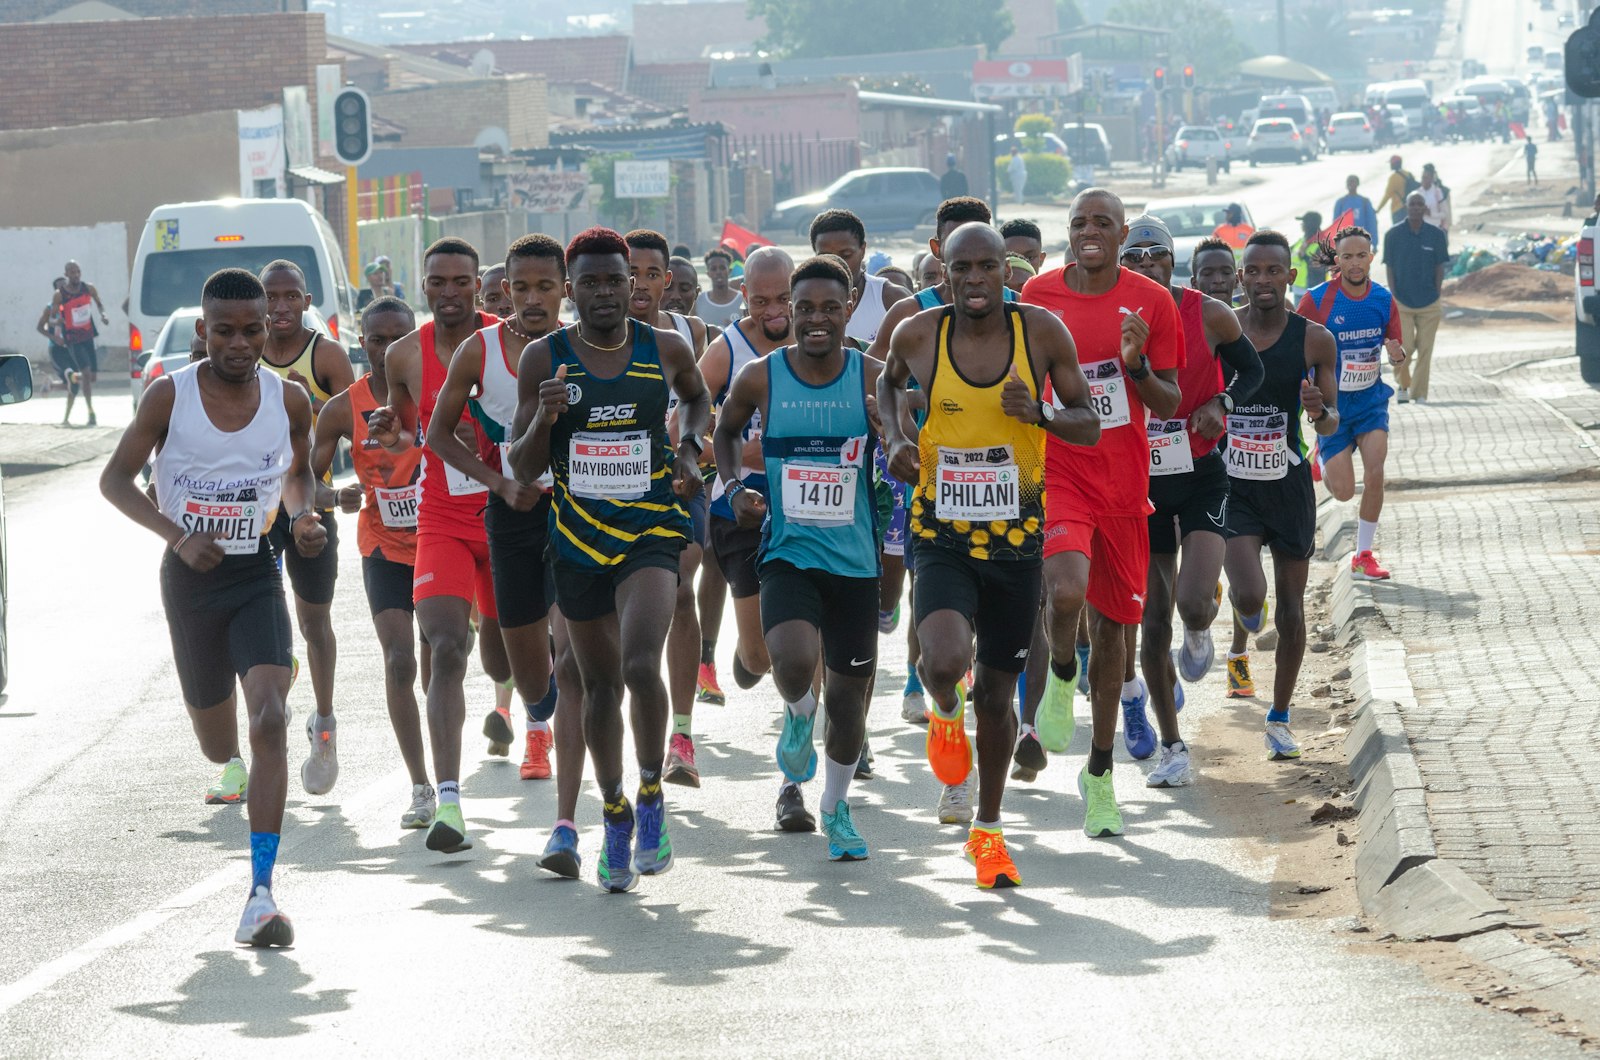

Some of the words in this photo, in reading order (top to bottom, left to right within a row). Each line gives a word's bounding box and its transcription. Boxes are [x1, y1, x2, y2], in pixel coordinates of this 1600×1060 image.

[1338, 328, 1382, 341] QHUBEKA
[1090, 385, 1104, 395] AR
[1236, 404, 1279, 414] medihelp
[586, 421, 608, 429] Sports
[609, 418, 638, 426] Nutrition
[1167, 422, 1181, 431] ASA
[1249, 420, 1265, 428] 2022
[1148, 437, 1170, 447] PAR
[1240, 441, 1274, 451] SPAR
[587, 446, 629, 455] SPAR
[846, 439, 860, 462] J
[944, 454, 960, 465] CGA
[964, 452, 984, 463] 2022
[988, 449, 1006, 458] ASA
[1151, 449, 1162, 466] 6
[1228, 448, 1287, 469] KATLEGO
[572, 460, 649, 476] MAYIBONGWE
[800, 471, 839, 481] SPAR
[953, 472, 996, 482] SPAR
[215, 492, 235, 502] 2022
[239, 488, 257, 500] ASA
[388, 489, 415, 500] SPA
[799, 482, 843, 507] 1410
[941, 482, 1014, 507] PHILANI
[199, 505, 242, 516] SPAR
[388, 498, 417, 518] CHP
[182, 512, 257, 541] SAMUEL
